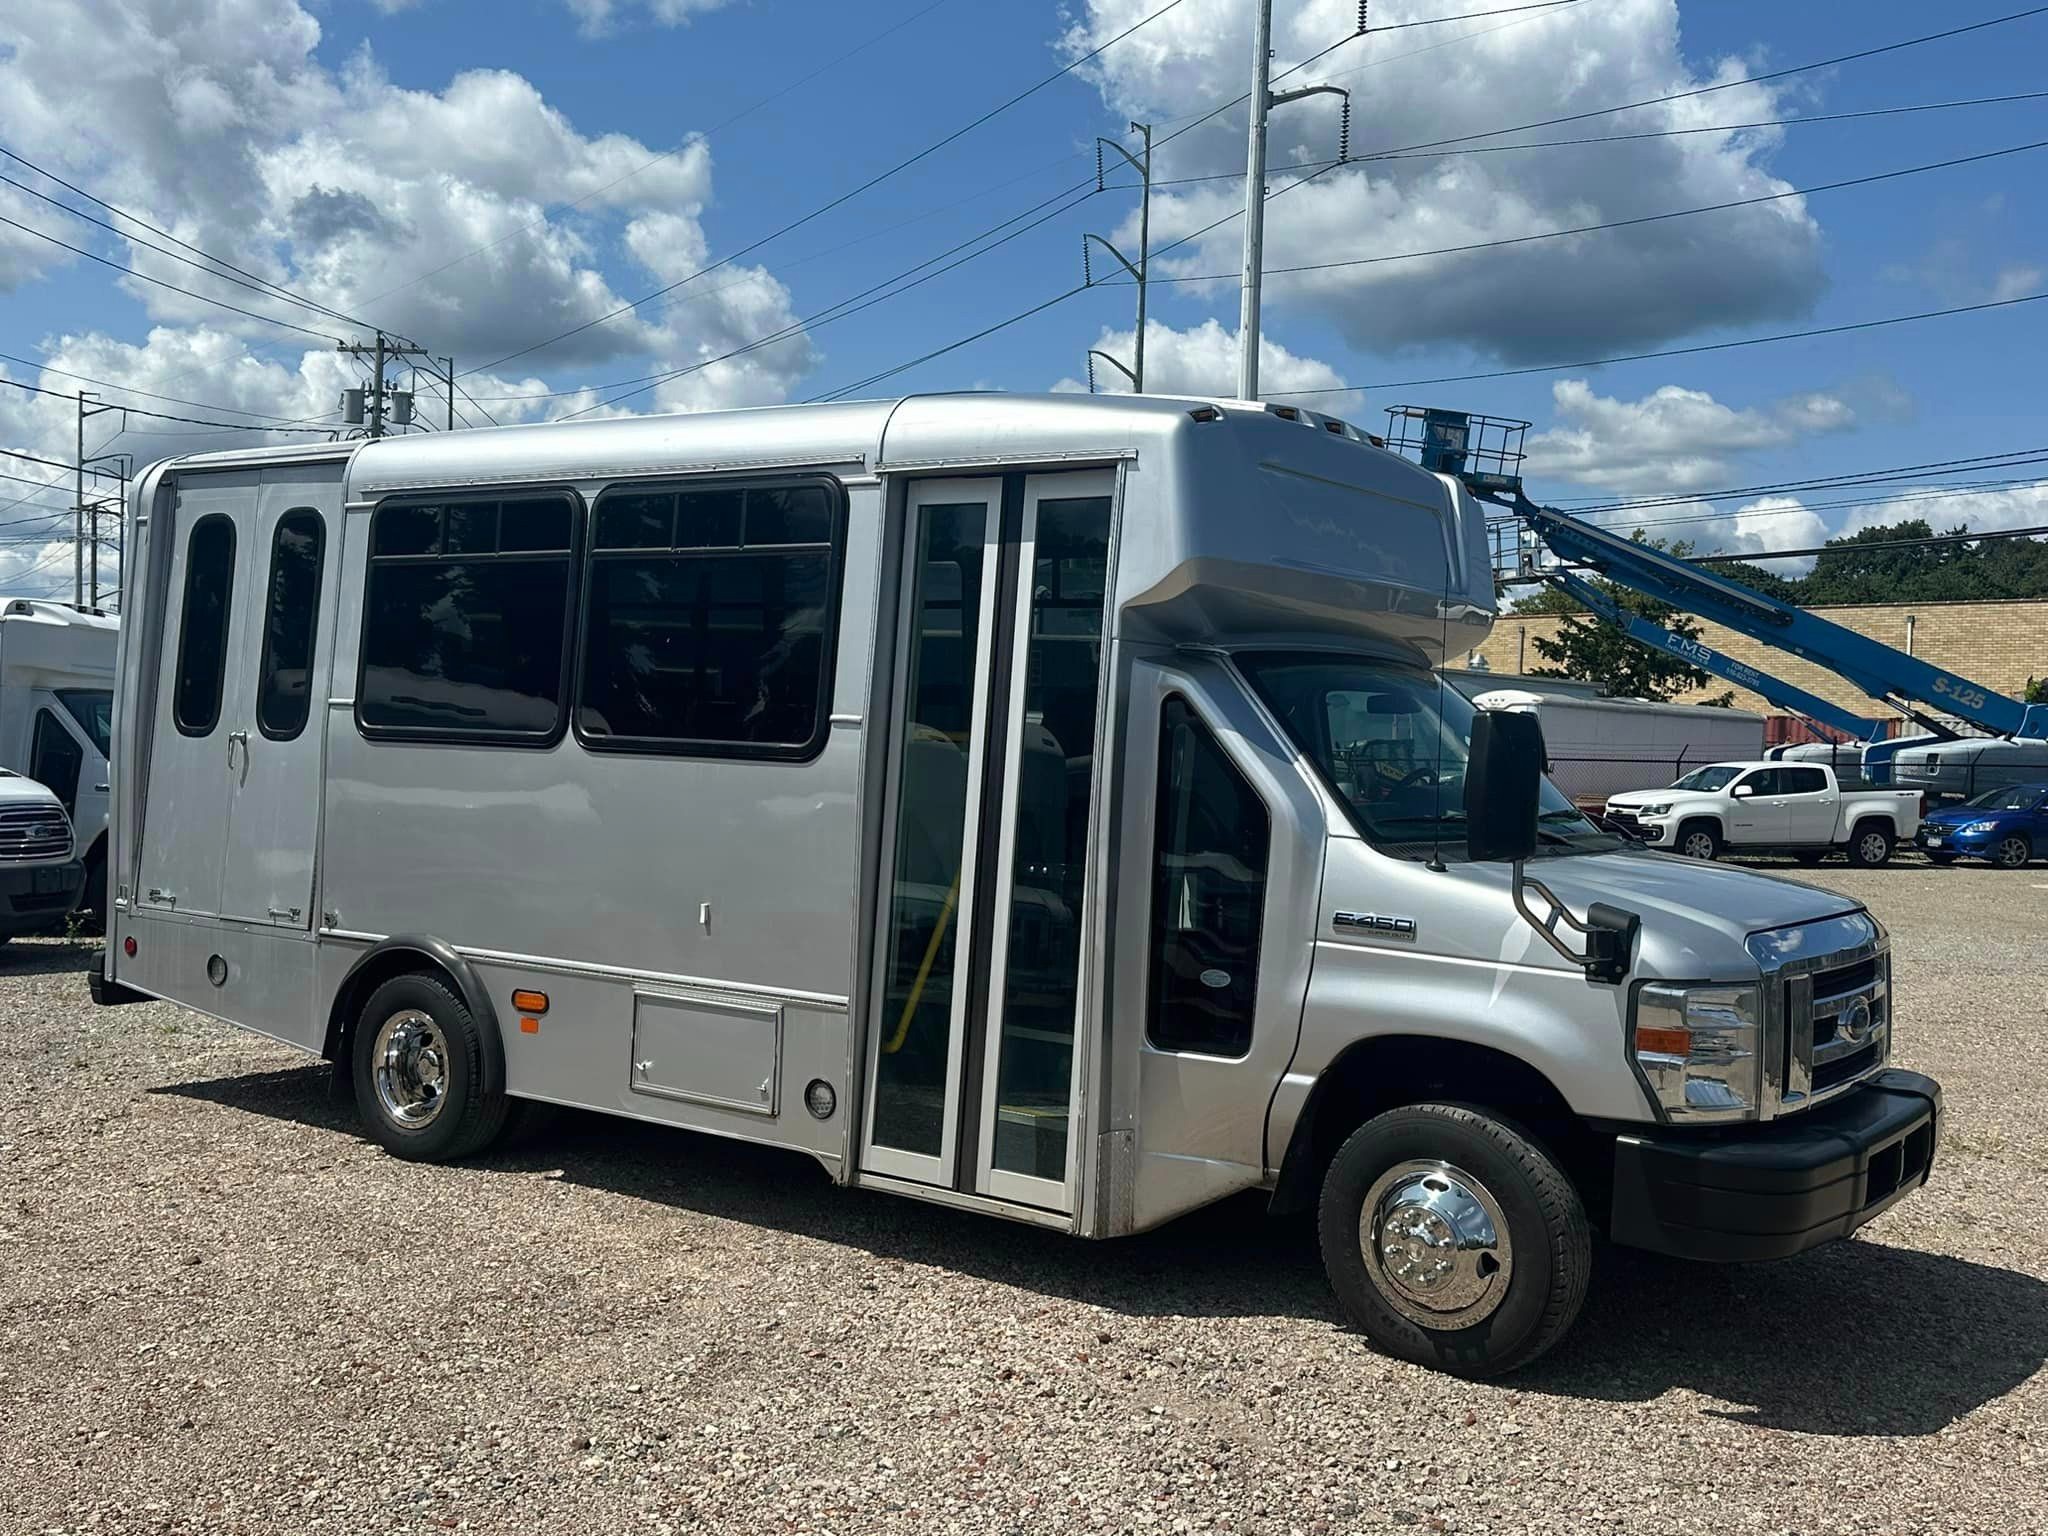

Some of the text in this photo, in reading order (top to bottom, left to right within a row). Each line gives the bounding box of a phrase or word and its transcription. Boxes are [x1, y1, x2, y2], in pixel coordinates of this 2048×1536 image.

[1667, 633, 1713, 660] FMS
[1931, 677, 1986, 709] S-125
[1332, 910, 1413, 932] E-450
